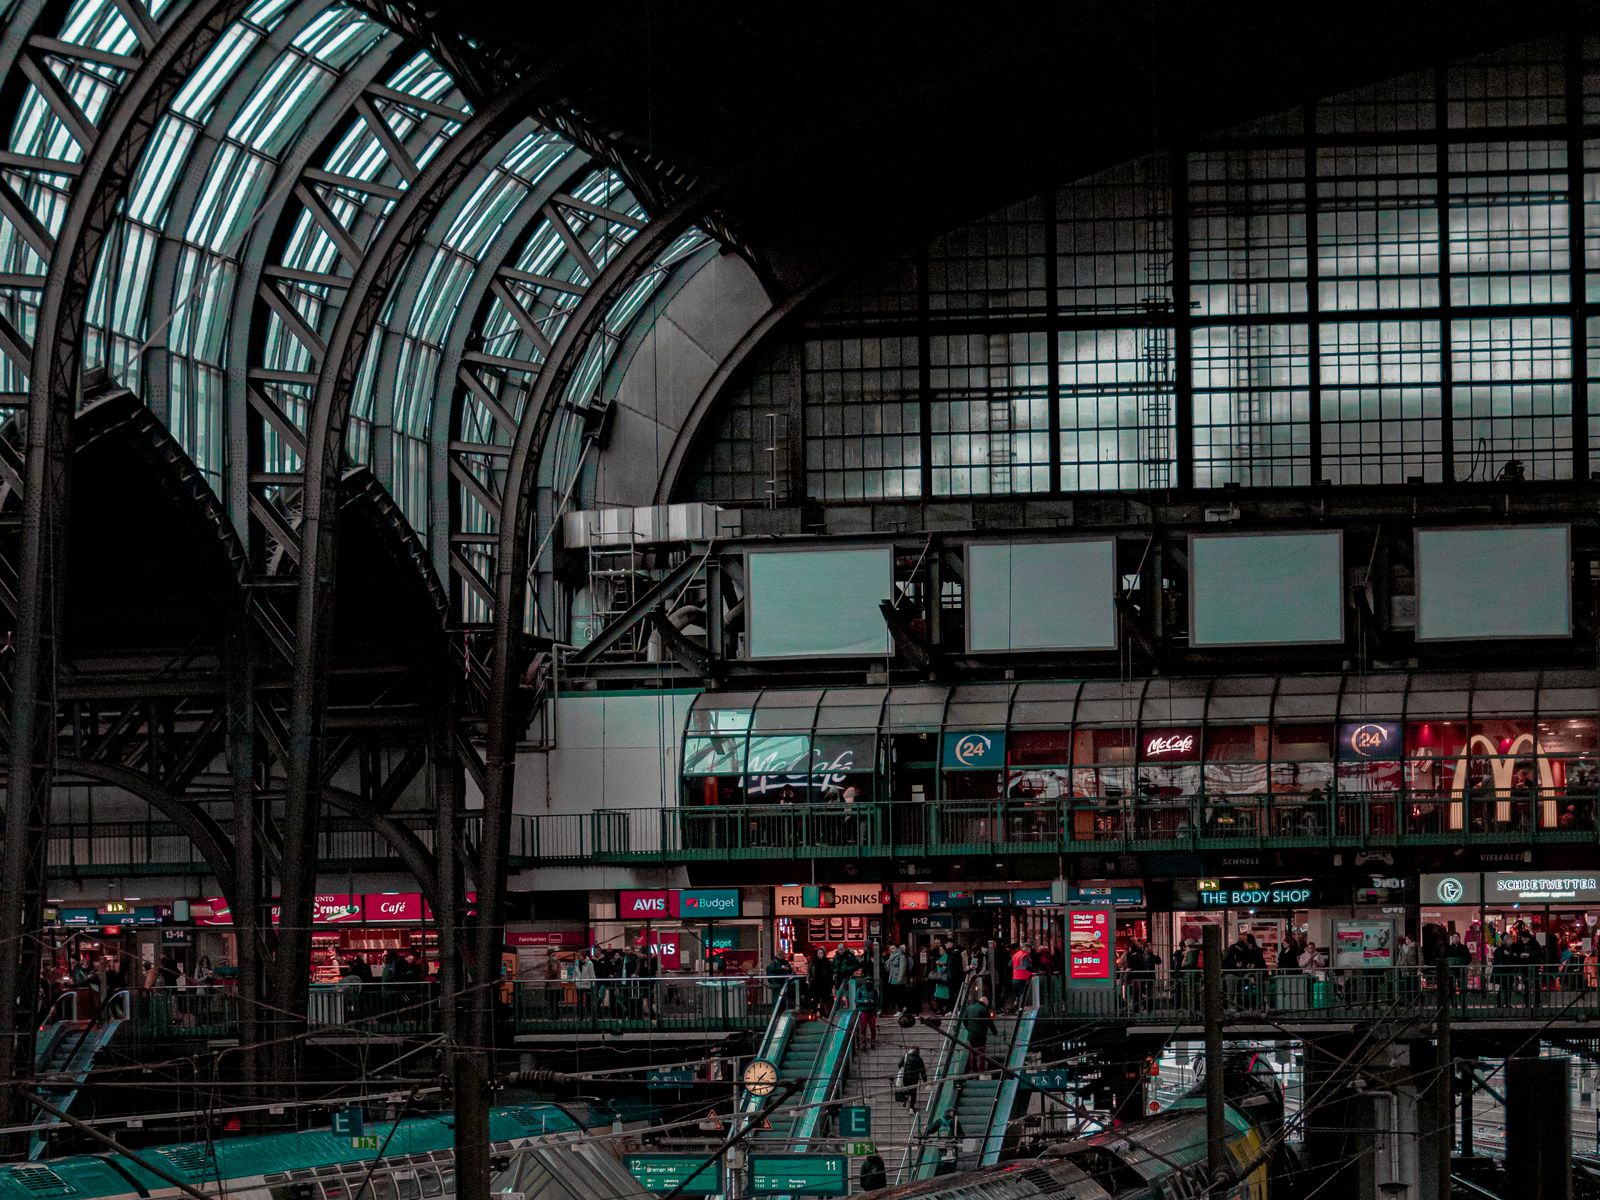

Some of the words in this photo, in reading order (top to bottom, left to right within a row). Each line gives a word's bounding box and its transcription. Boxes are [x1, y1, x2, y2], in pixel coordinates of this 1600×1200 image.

[1147, 735, 1193, 756] McCafé
[1360, 732, 1381, 748] 24
[963, 743, 985, 757] 24
[899, 866, 932, 875] WZIG
[1497, 879, 1597, 890] SCHIETWETTER
[835, 894, 877, 905] DRINKS
[1201, 892, 1227, 904] THE
[1232, 890, 1270, 903] BODY
[1273, 889, 1310, 902] SHOP
[380, 901, 406, 916] Café
[633, 898, 665, 911] AVIS
[699, 898, 735, 910] Budget
[912, 917, 928, 925] 11-12
[165, 930, 184, 939] 13-14
[851, 1108, 866, 1132] E
[631, 1160, 641, 1170] 12
[826, 1161, 836, 1171] 11
